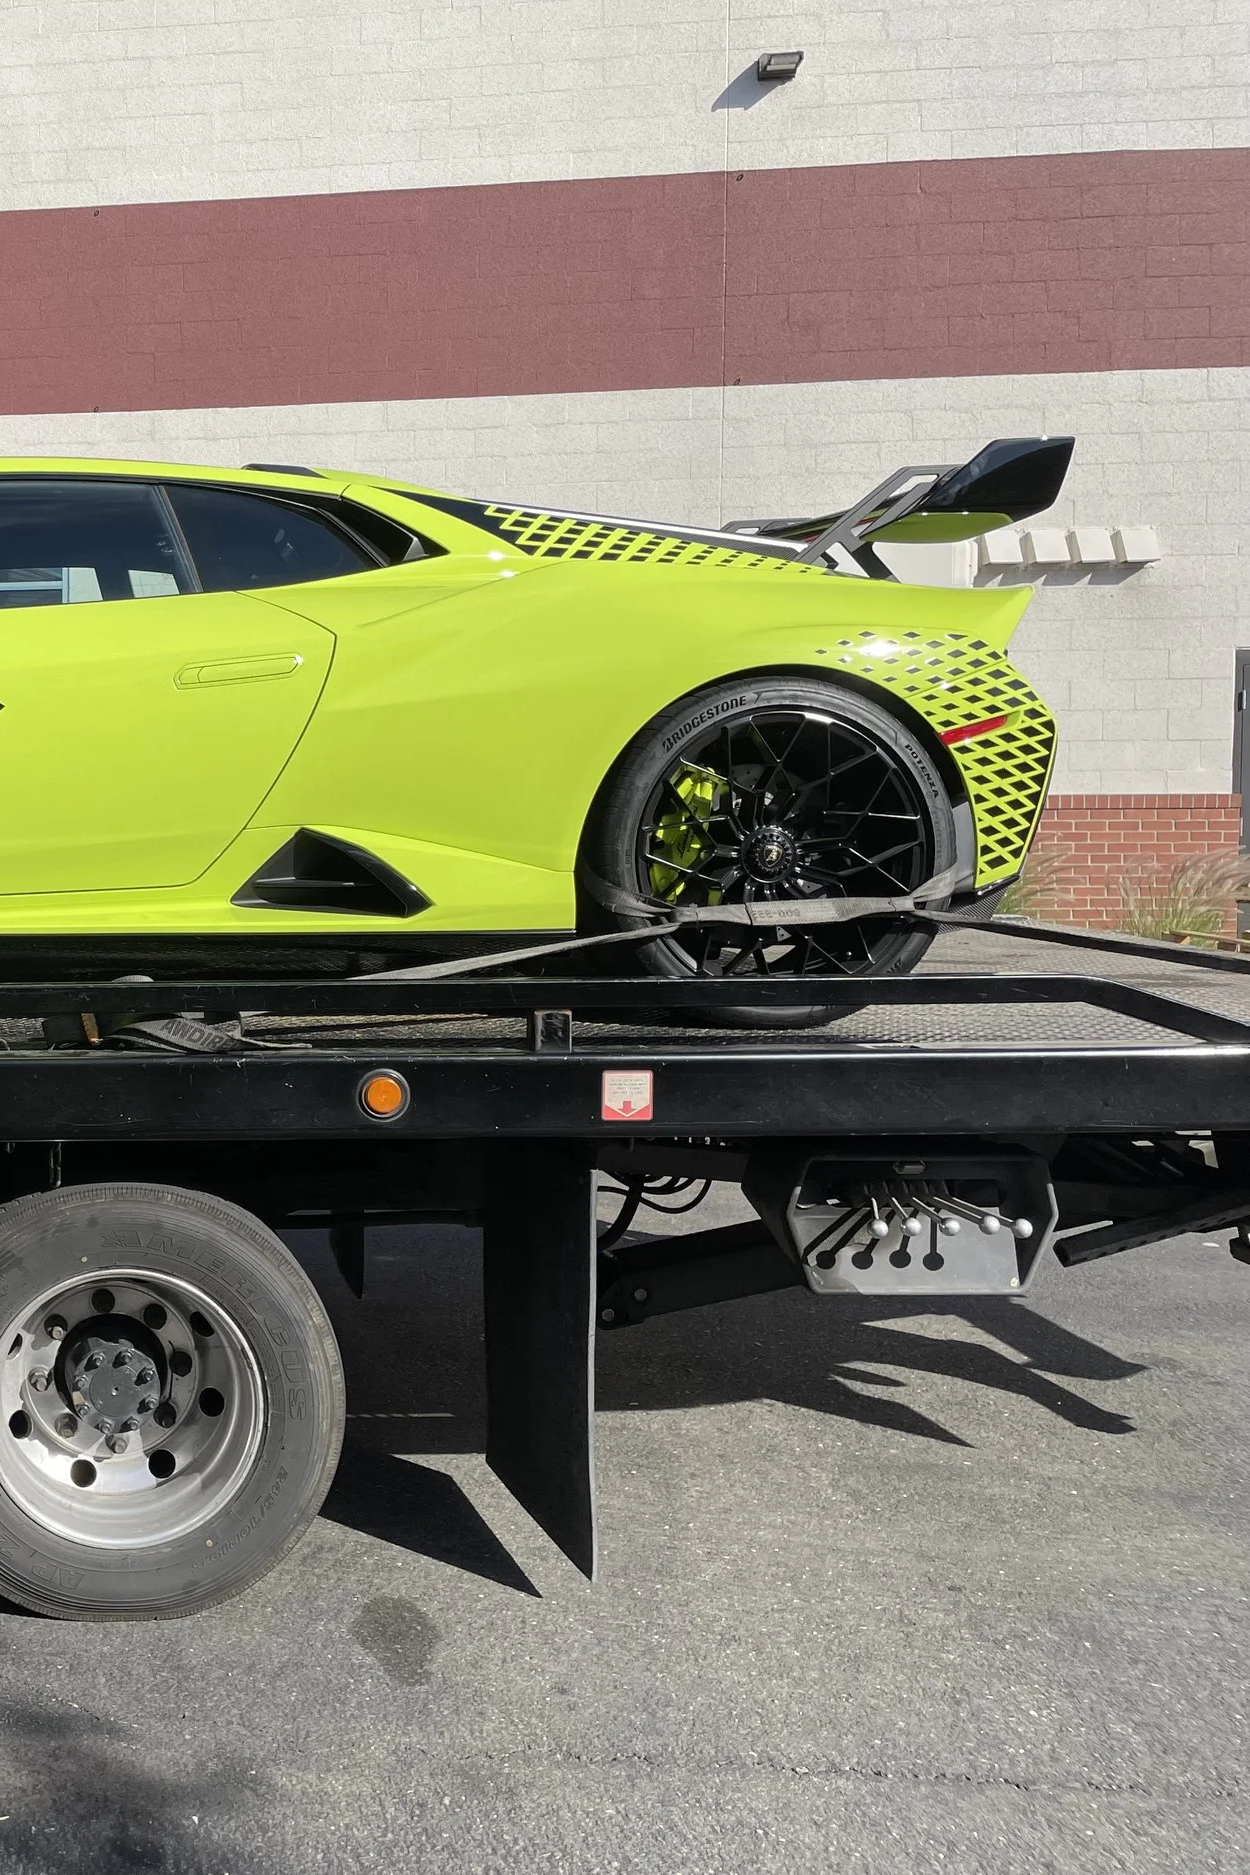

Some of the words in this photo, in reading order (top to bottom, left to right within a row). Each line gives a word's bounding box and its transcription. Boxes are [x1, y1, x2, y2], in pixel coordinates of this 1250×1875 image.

[661, 694, 747, 754] BRIDGESTONE
[903, 743, 939, 798] POTENZA
[99, 1228, 308, 1423] AMERICUS
[31, 1557, 87, 1591] AP
